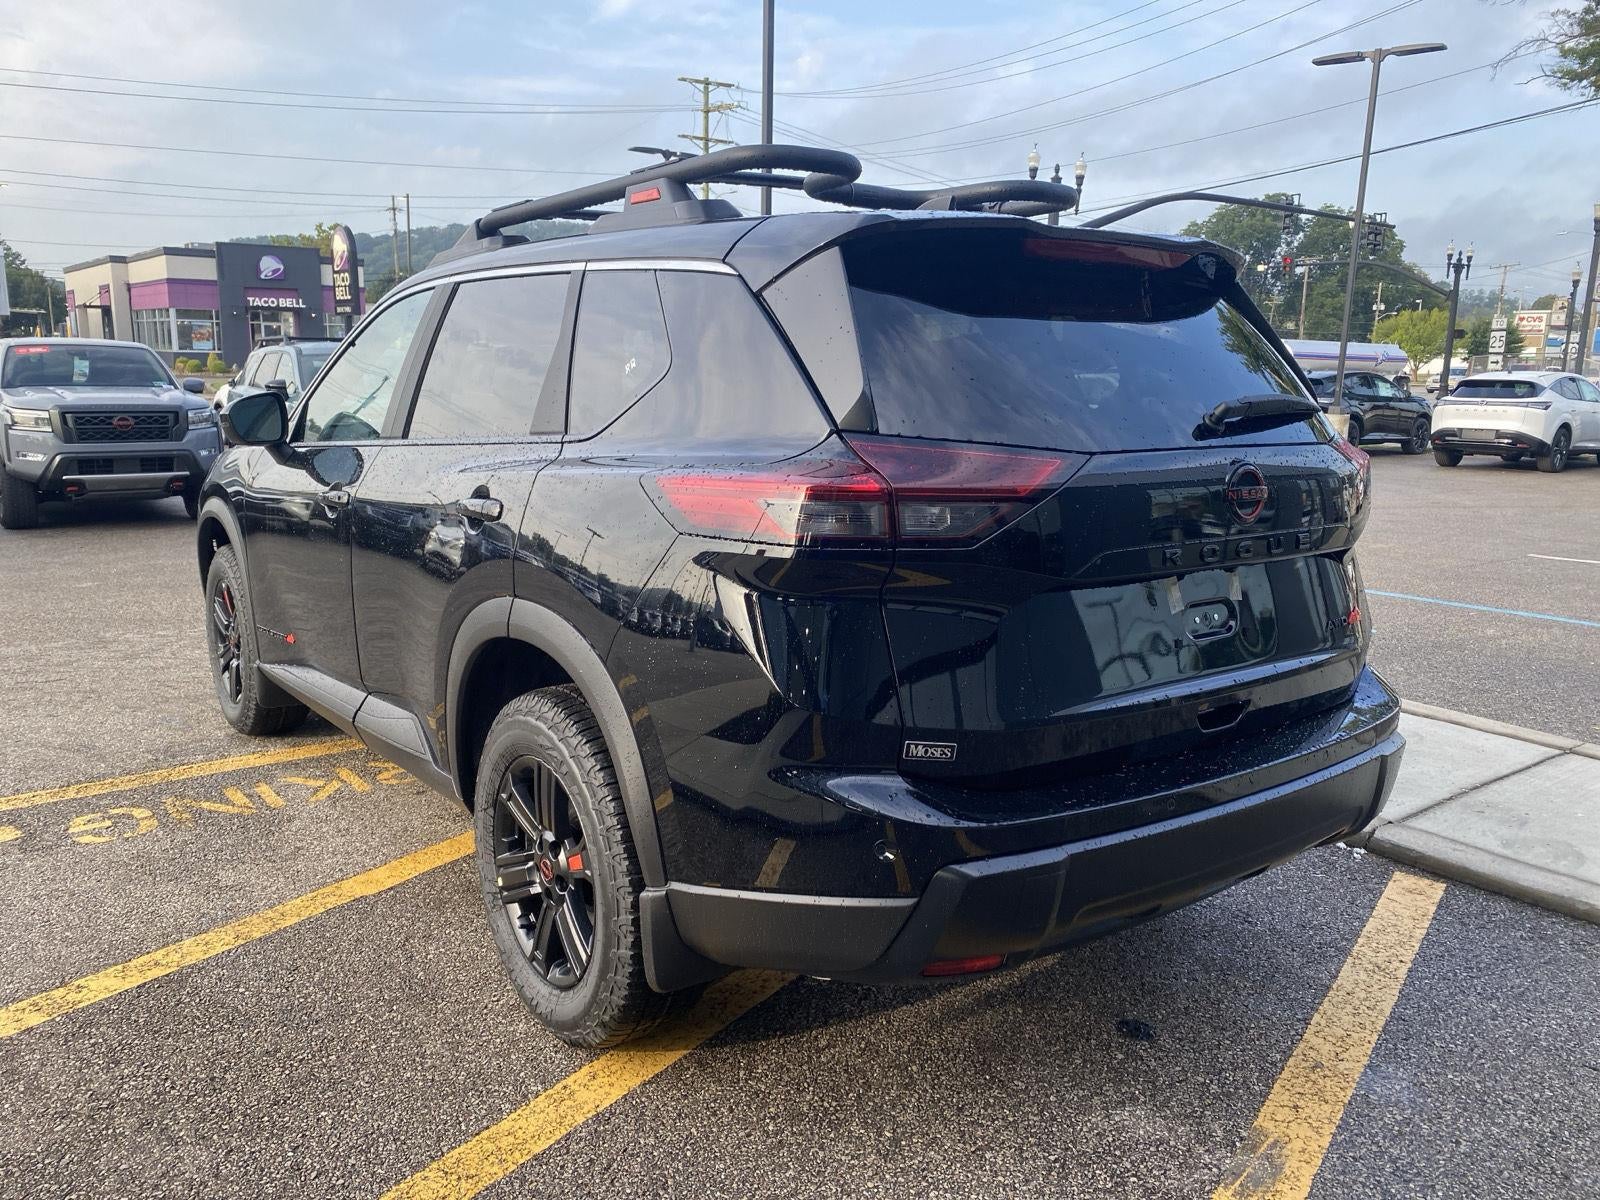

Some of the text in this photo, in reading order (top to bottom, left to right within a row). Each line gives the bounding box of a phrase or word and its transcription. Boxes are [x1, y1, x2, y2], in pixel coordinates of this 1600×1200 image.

[333, 272, 350, 287] TACO
[335, 286, 352, 300] BELL
[247, 296, 306, 309] TACO BELL
[1495, 320, 1505, 328] TO
[1526, 315, 1544, 323] CVS
[1489, 335, 1505, 349] 25
[1162, 530, 1311, 568] ROGUE
[909, 744, 952, 758] MOSES
